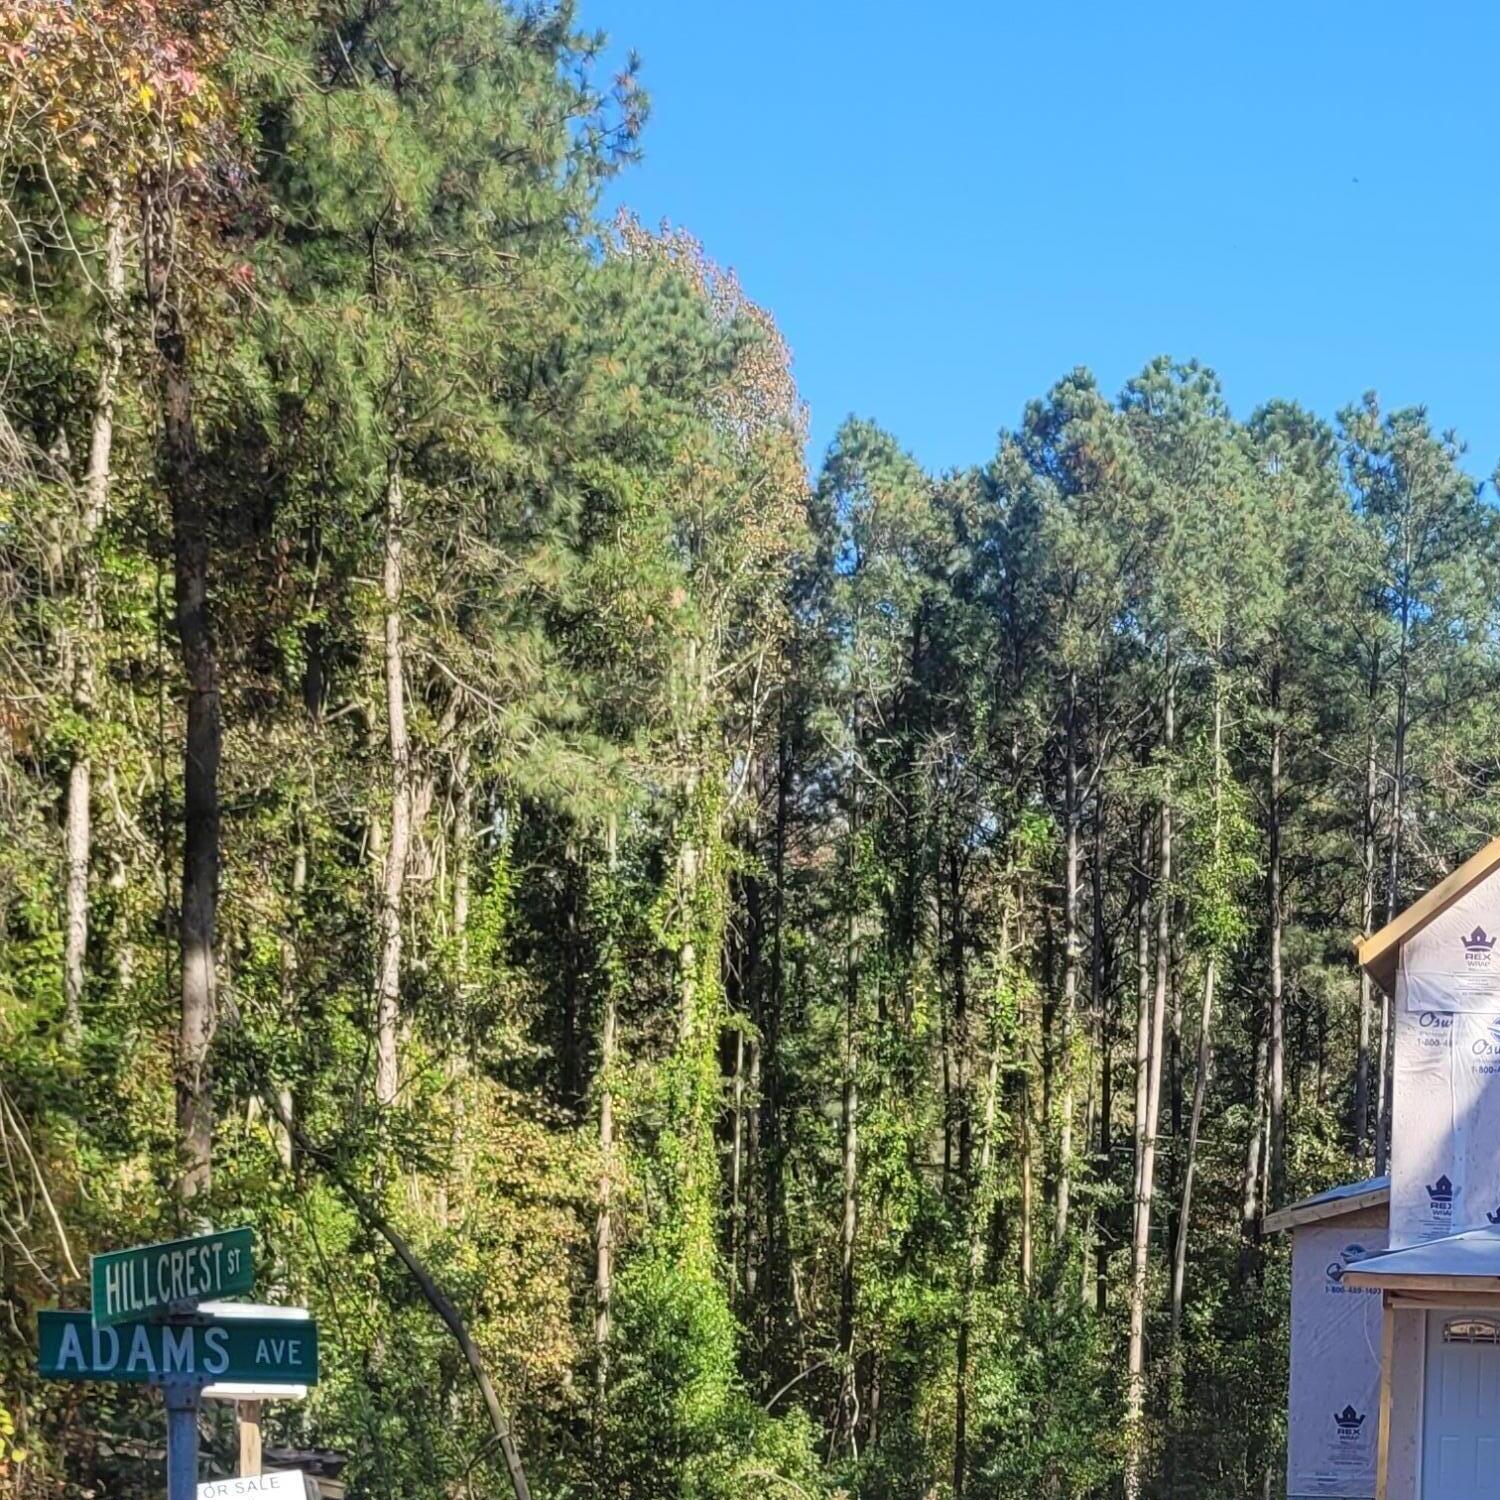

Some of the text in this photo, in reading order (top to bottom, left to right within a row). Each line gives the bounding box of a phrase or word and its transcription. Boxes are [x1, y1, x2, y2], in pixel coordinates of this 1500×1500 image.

[1465, 953, 1491, 961] REX
[106, 1242, 241, 1315] HILLCREST ST
[55, 1322, 302, 1374] ADAMS AVE
[1337, 1428, 1360, 1436] REX
[203, 1476, 281, 1499] OR SALE
